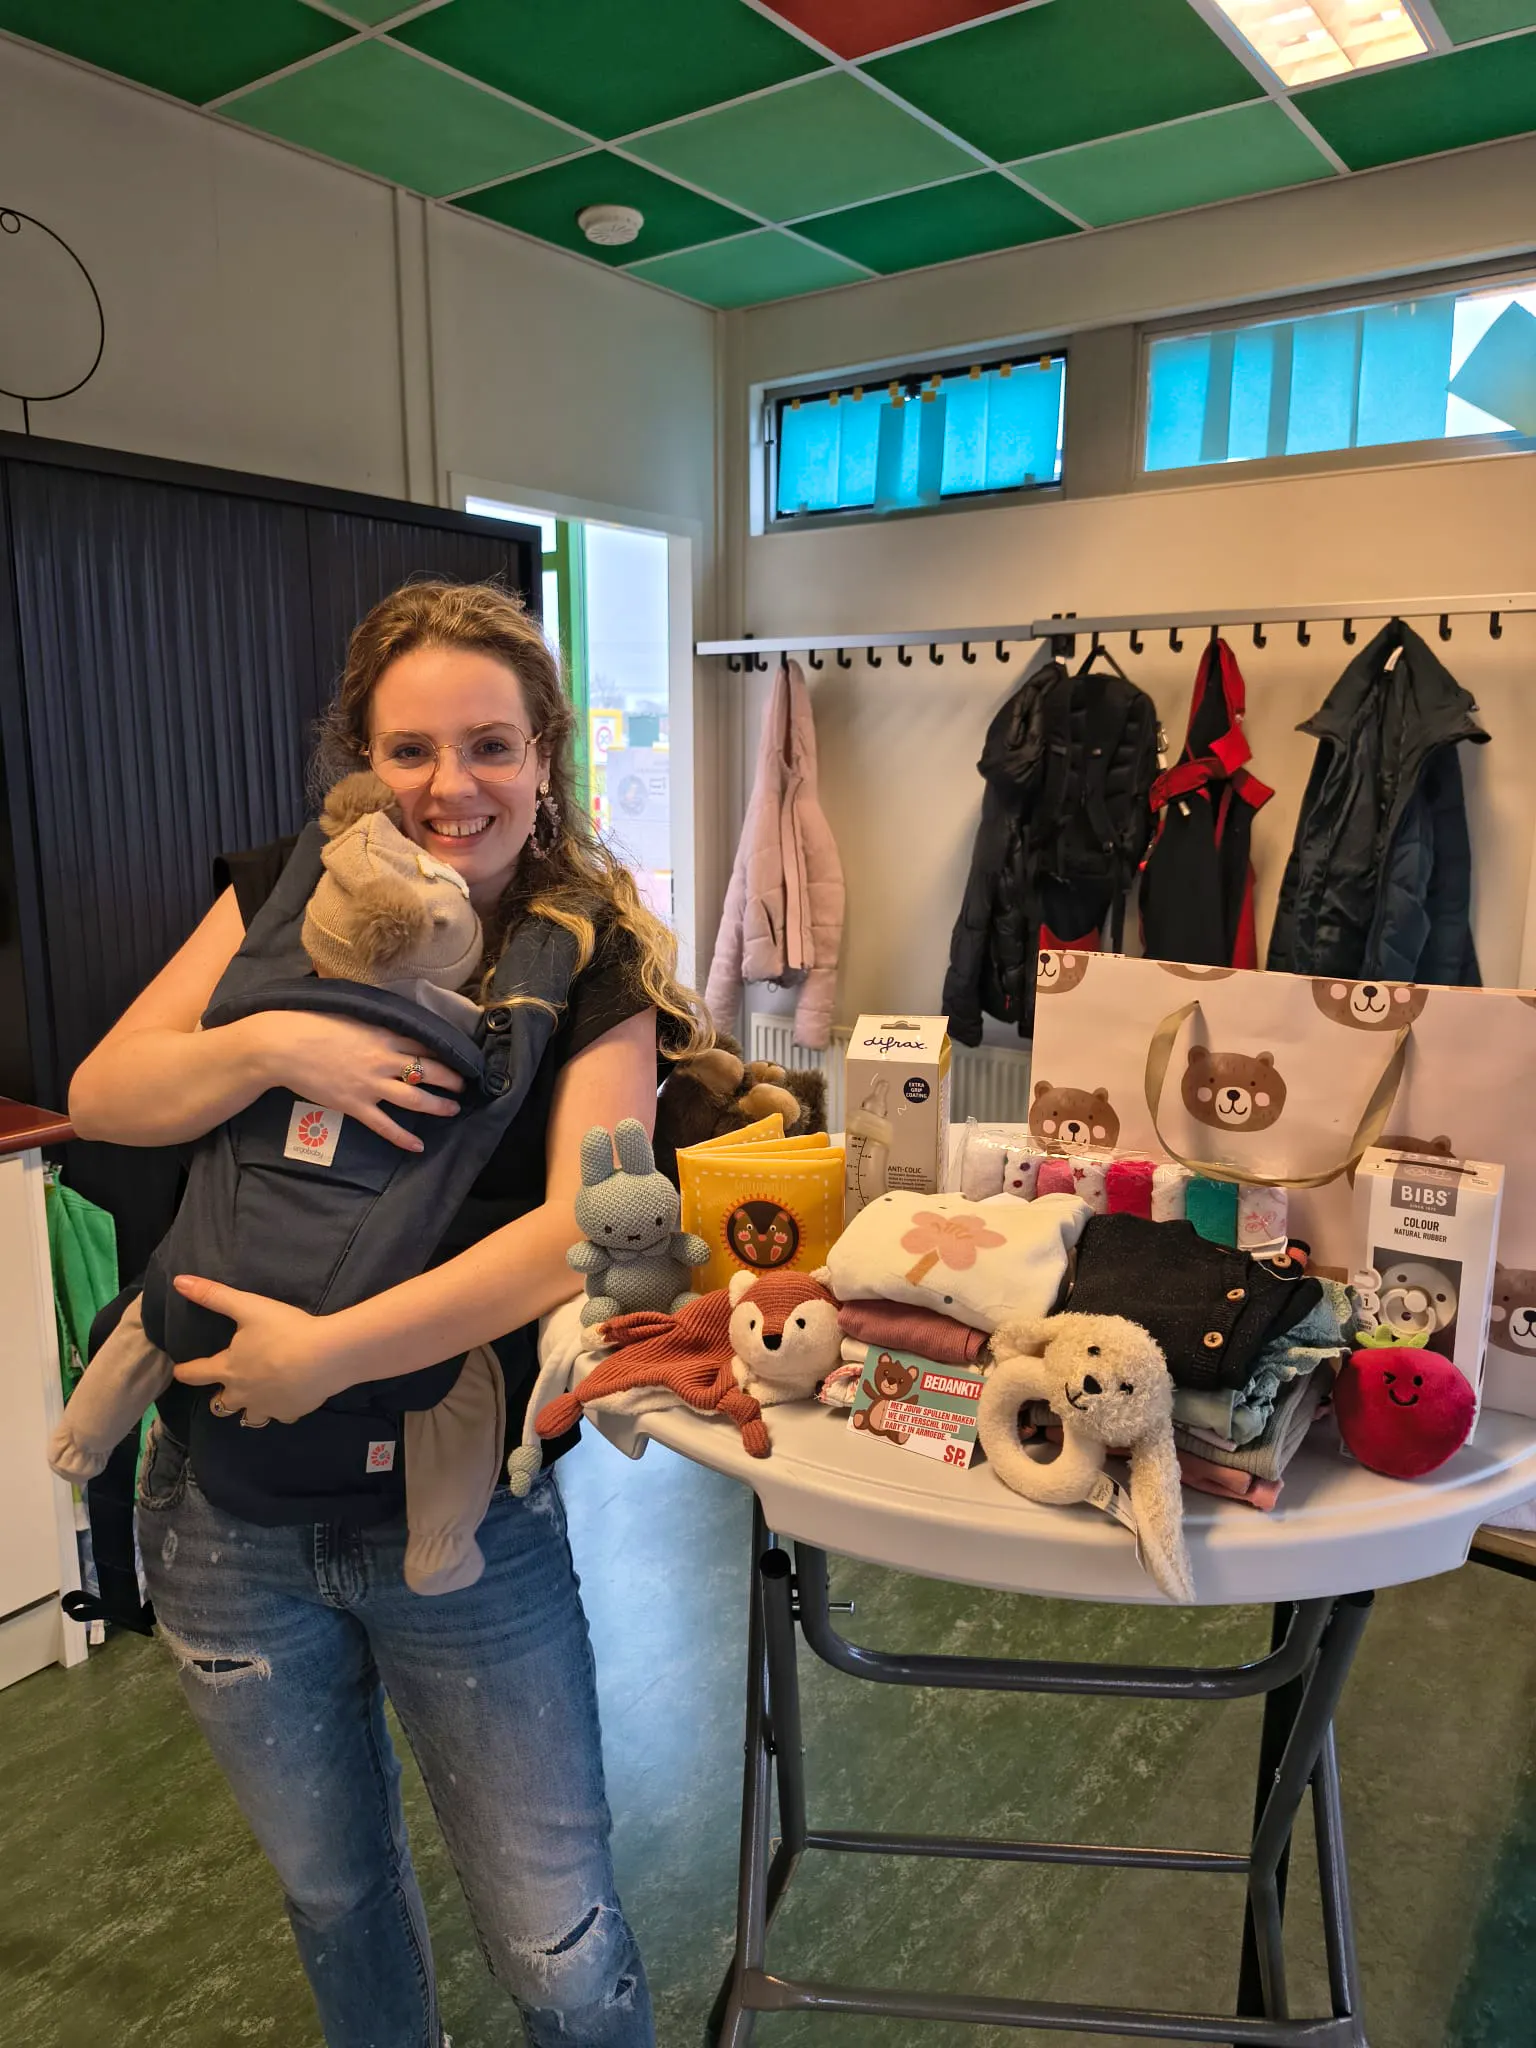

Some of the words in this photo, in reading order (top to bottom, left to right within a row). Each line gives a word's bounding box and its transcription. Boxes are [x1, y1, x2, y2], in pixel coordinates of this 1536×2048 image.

[863, 1036, 925, 1054] difrax
[887, 1166, 922, 1174] ANTI-COLIC
[1401, 1185, 1448, 1207] BIBS
[1403, 1216, 1440, 1232] COLOUR
[1394, 1227, 1422, 1239] NATURAL
[1422, 1232, 1448, 1243] RUBBER
[923, 1374, 980, 1398] BEDANKT!
[887, 1411, 897, 1420] WE
[898, 1413, 910, 1422] HET
[911, 1415, 940, 1429] VERSCHIL
[941, 1422, 958, 1433] VOOR
[889, 1401, 903, 1409] MET
[904, 1404, 922, 1415] JOUW
[923, 1408, 951, 1421] SPULLEN
[951, 1414, 975, 1426] MAKEN
[884, 1420, 906, 1432] BABY'S
[907, 1425, 915, 1434] IN
[916, 1428, 947, 1441] ARMOEDE.
